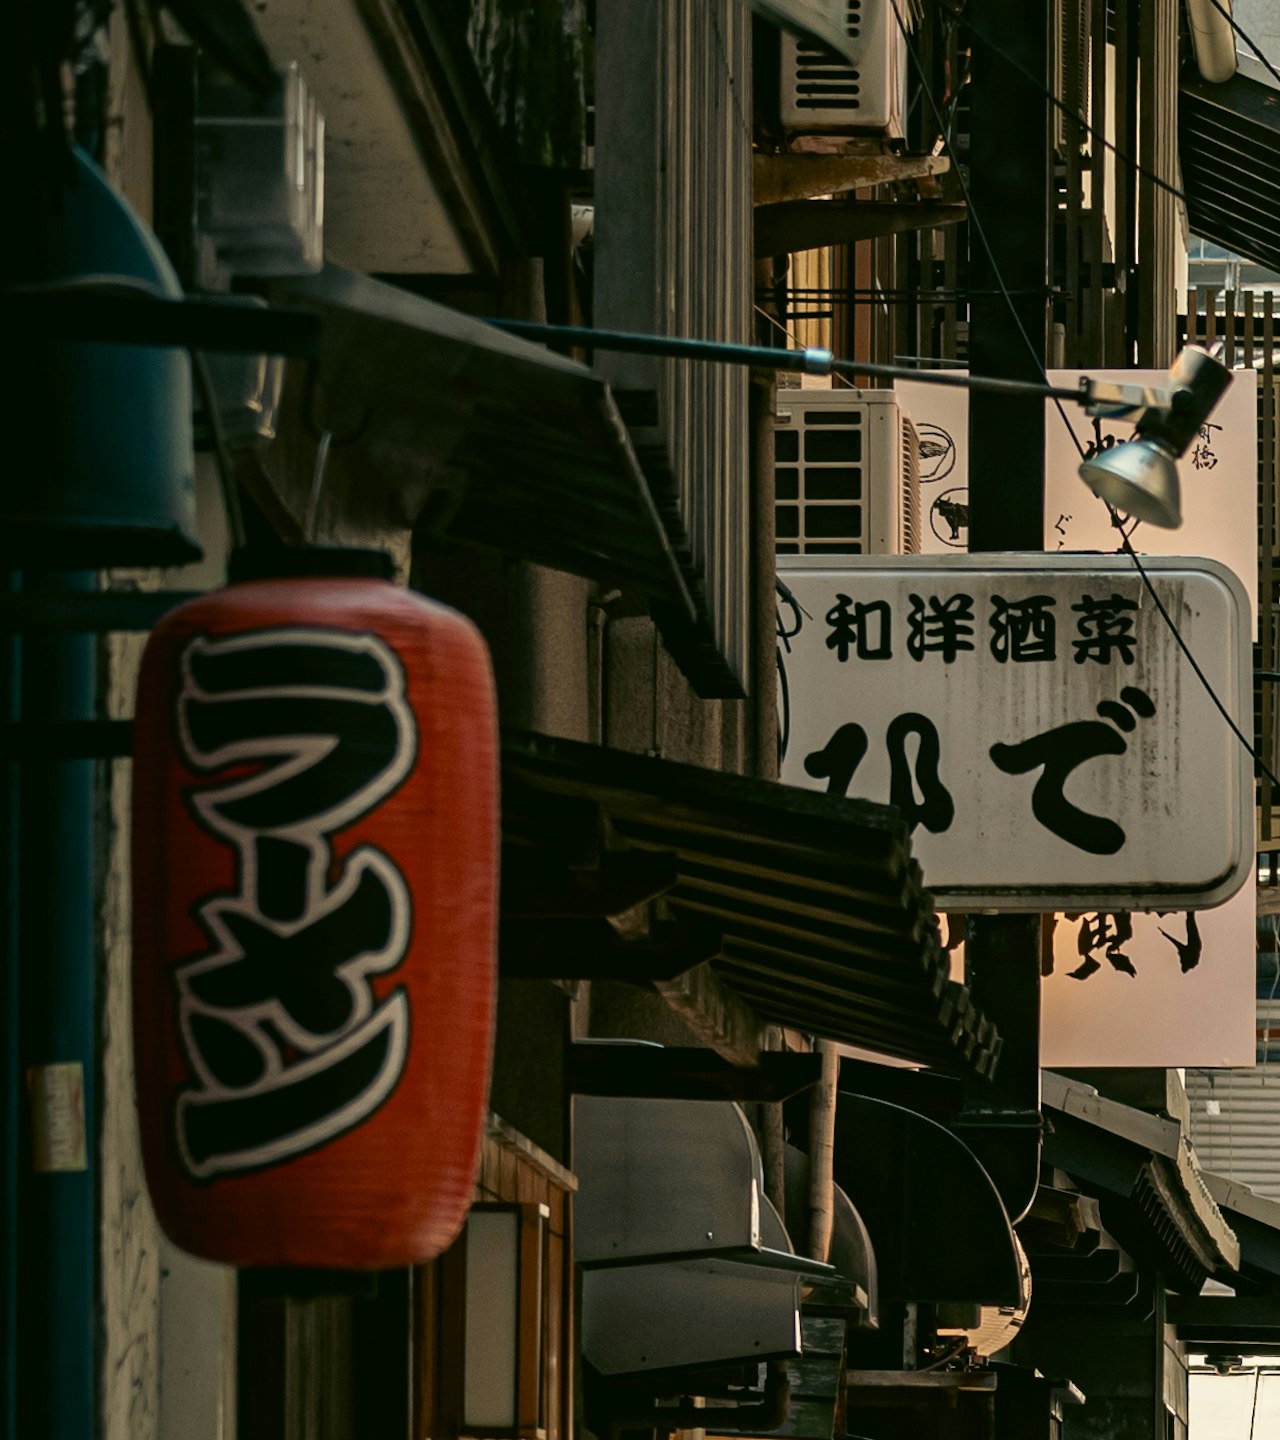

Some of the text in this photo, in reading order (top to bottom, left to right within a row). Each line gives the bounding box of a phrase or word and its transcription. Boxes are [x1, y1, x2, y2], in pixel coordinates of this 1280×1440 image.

[825, 593, 1140, 667] 和洋酒菜
[175, 625, 420, 1182] ラーメン
